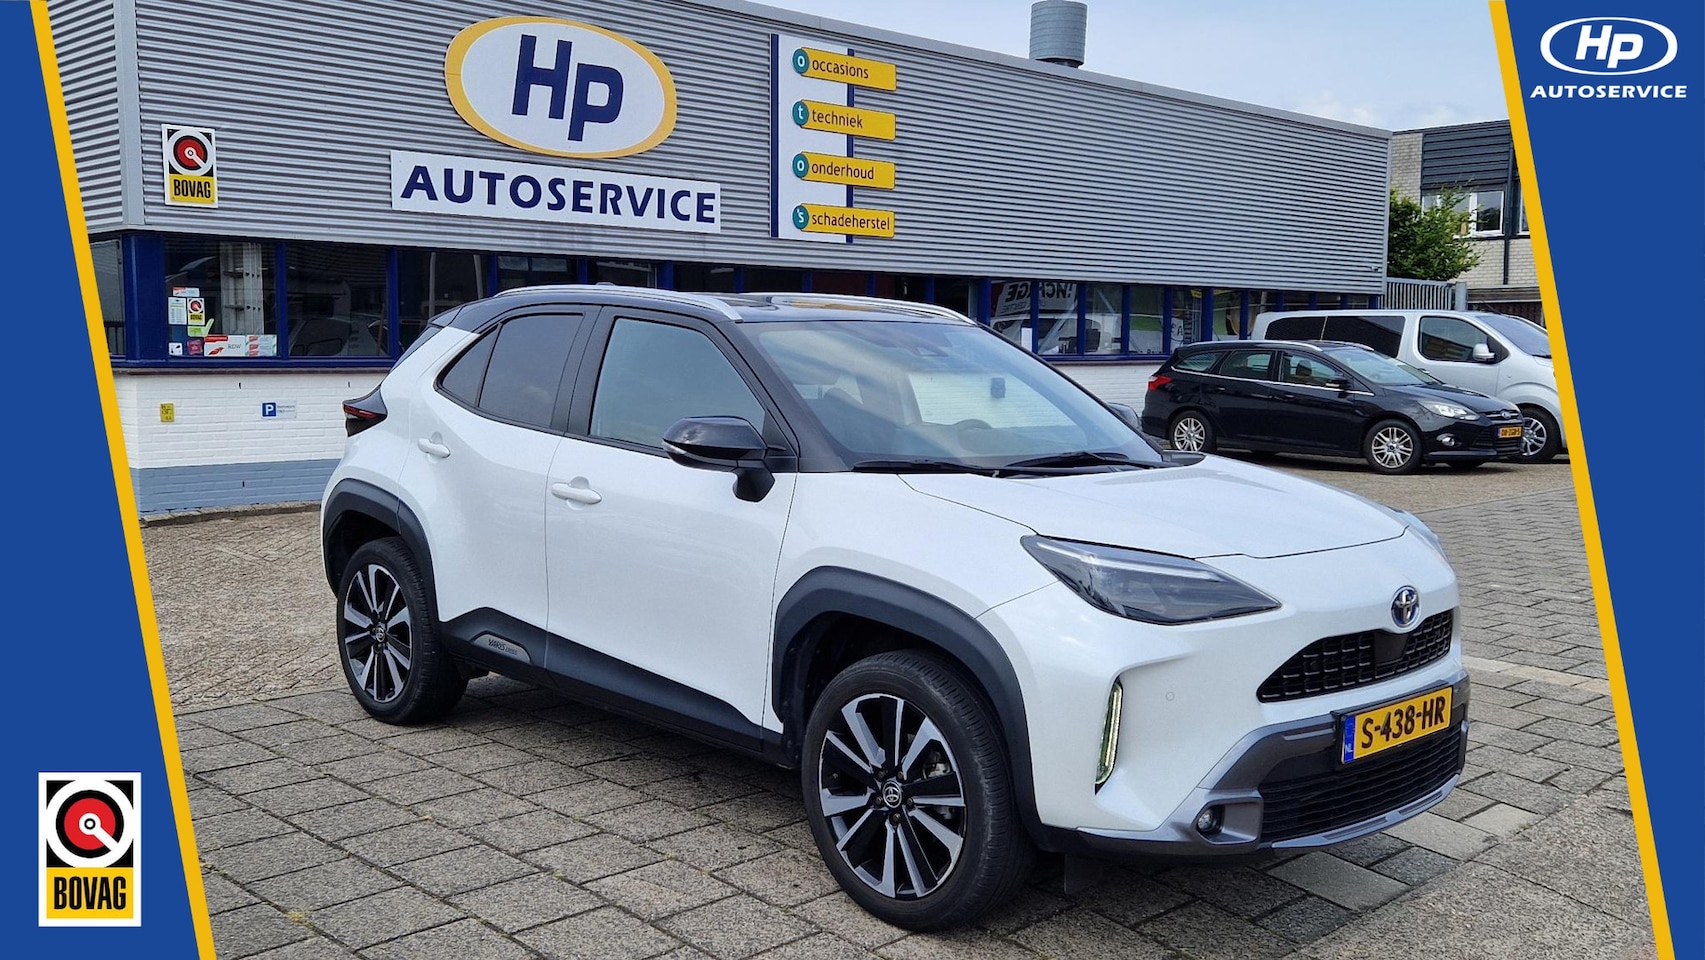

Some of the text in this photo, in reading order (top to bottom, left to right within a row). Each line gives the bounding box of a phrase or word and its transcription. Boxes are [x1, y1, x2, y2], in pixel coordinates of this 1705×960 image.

[812, 59, 869, 79] occasions
[511, 34, 624, 142] Hp
[812, 110, 863, 129] techniek
[811, 162, 874, 180] onderhoud
[173, 179, 211, 199] BOVAG
[400, 165, 716, 224] AUTOSERVICE
[811, 212, 890, 230] schadeherstel
[1361, 696, 1445, 749] S-438-HR
